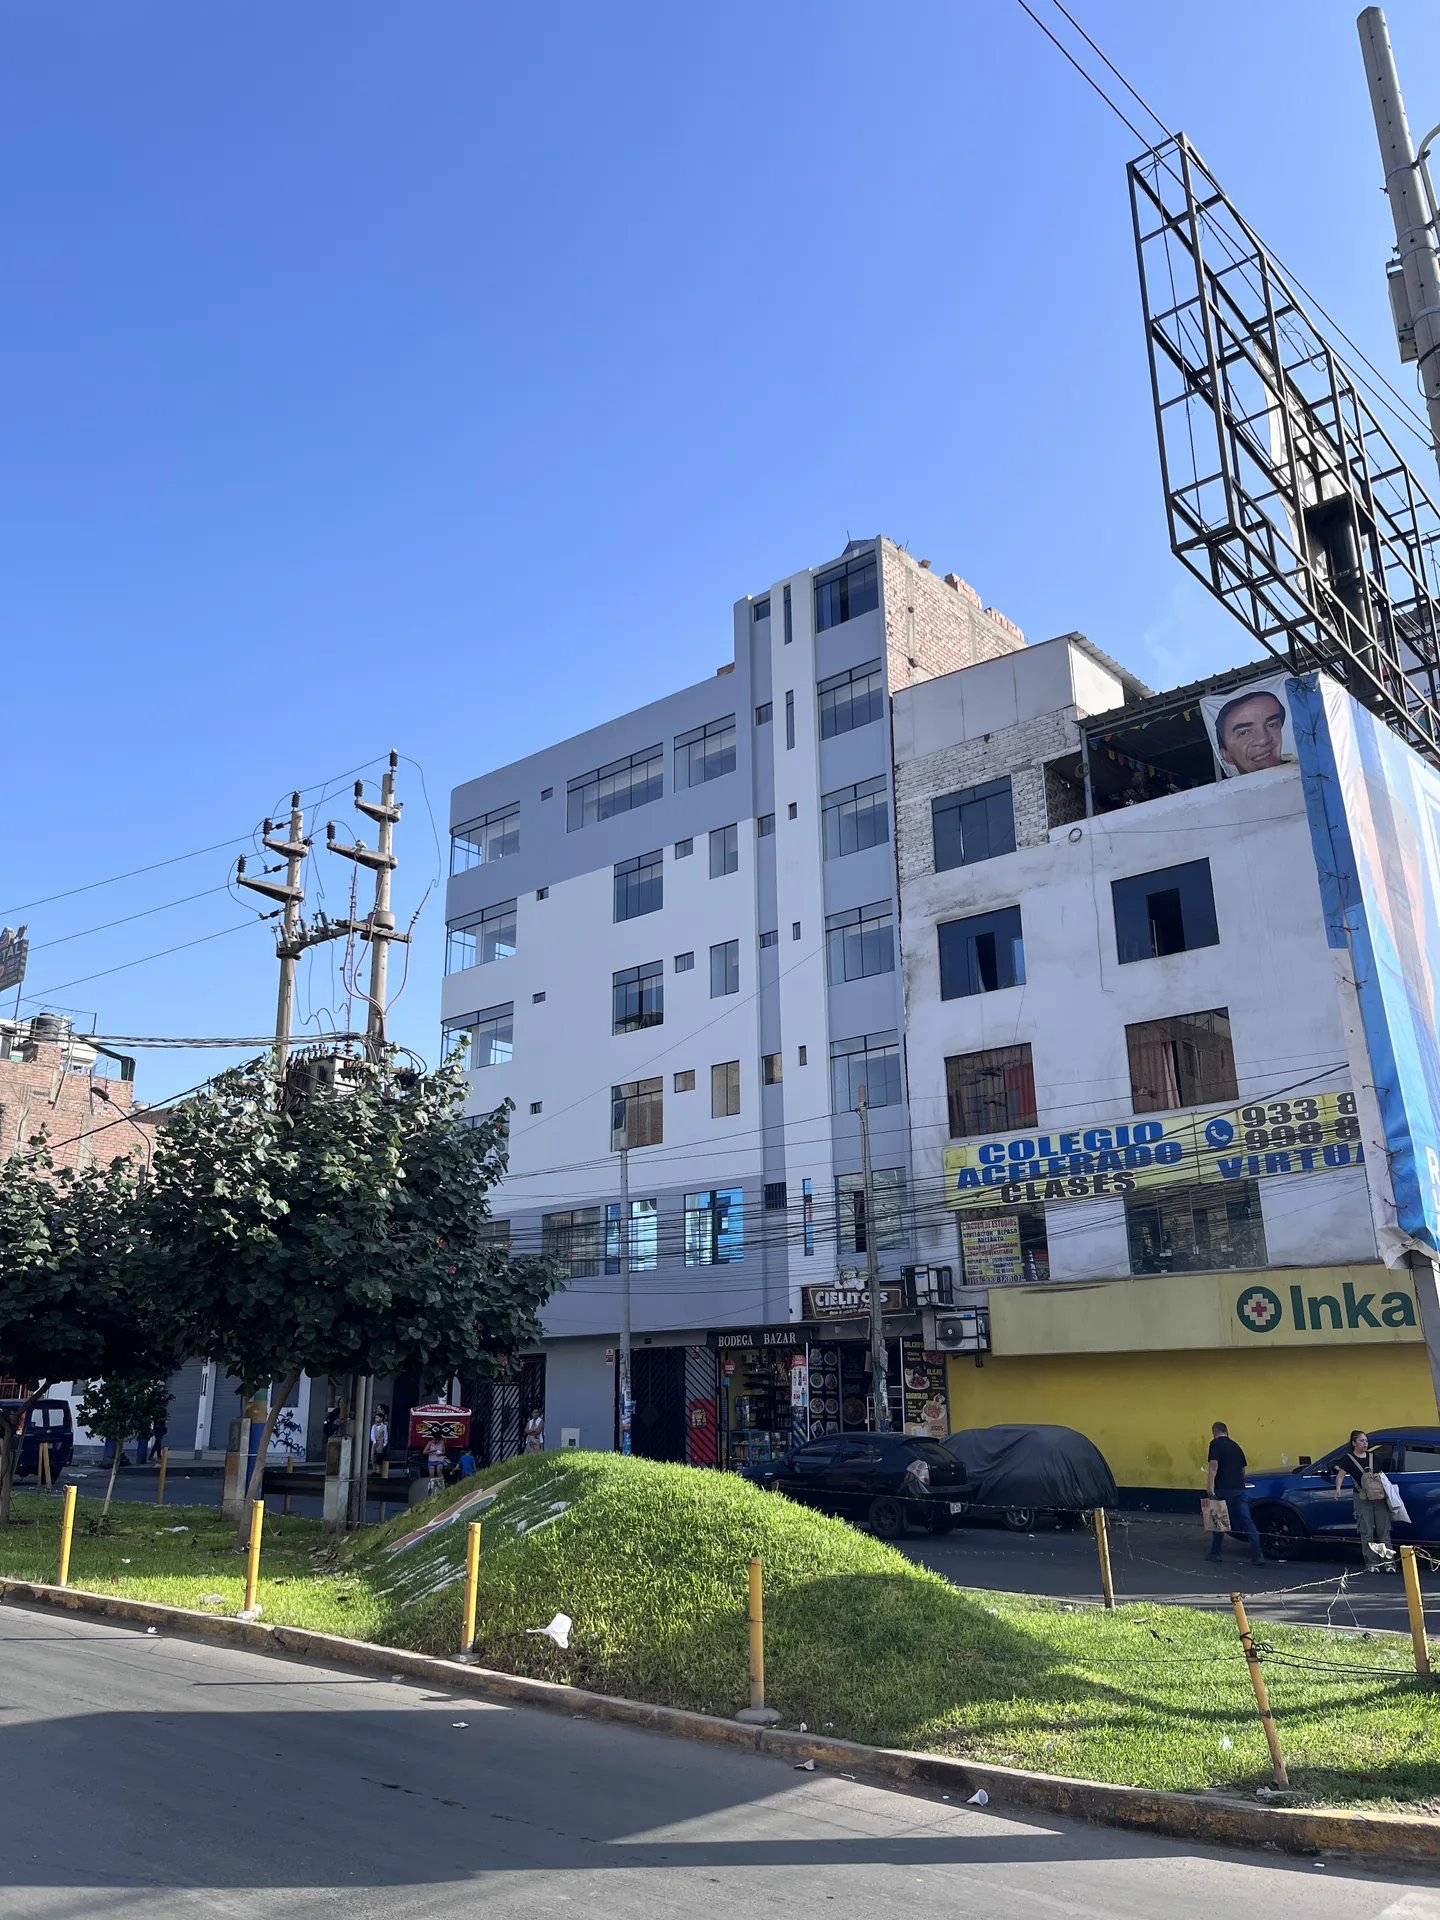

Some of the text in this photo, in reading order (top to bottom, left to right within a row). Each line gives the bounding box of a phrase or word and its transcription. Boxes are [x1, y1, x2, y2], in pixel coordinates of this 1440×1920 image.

[1241, 1098, 1319, 1129] 933
[978, 1121, 1163, 1165] COLEGIO
[1244, 1120, 1324, 1151] 998
[956, 1141, 1183, 1190] ACELERADO
[1000, 1171, 1137, 1204] CLASES
[1289, 1282, 1417, 1331] Inka
[718, 1332, 796, 1347] BODEGA BAZAR
